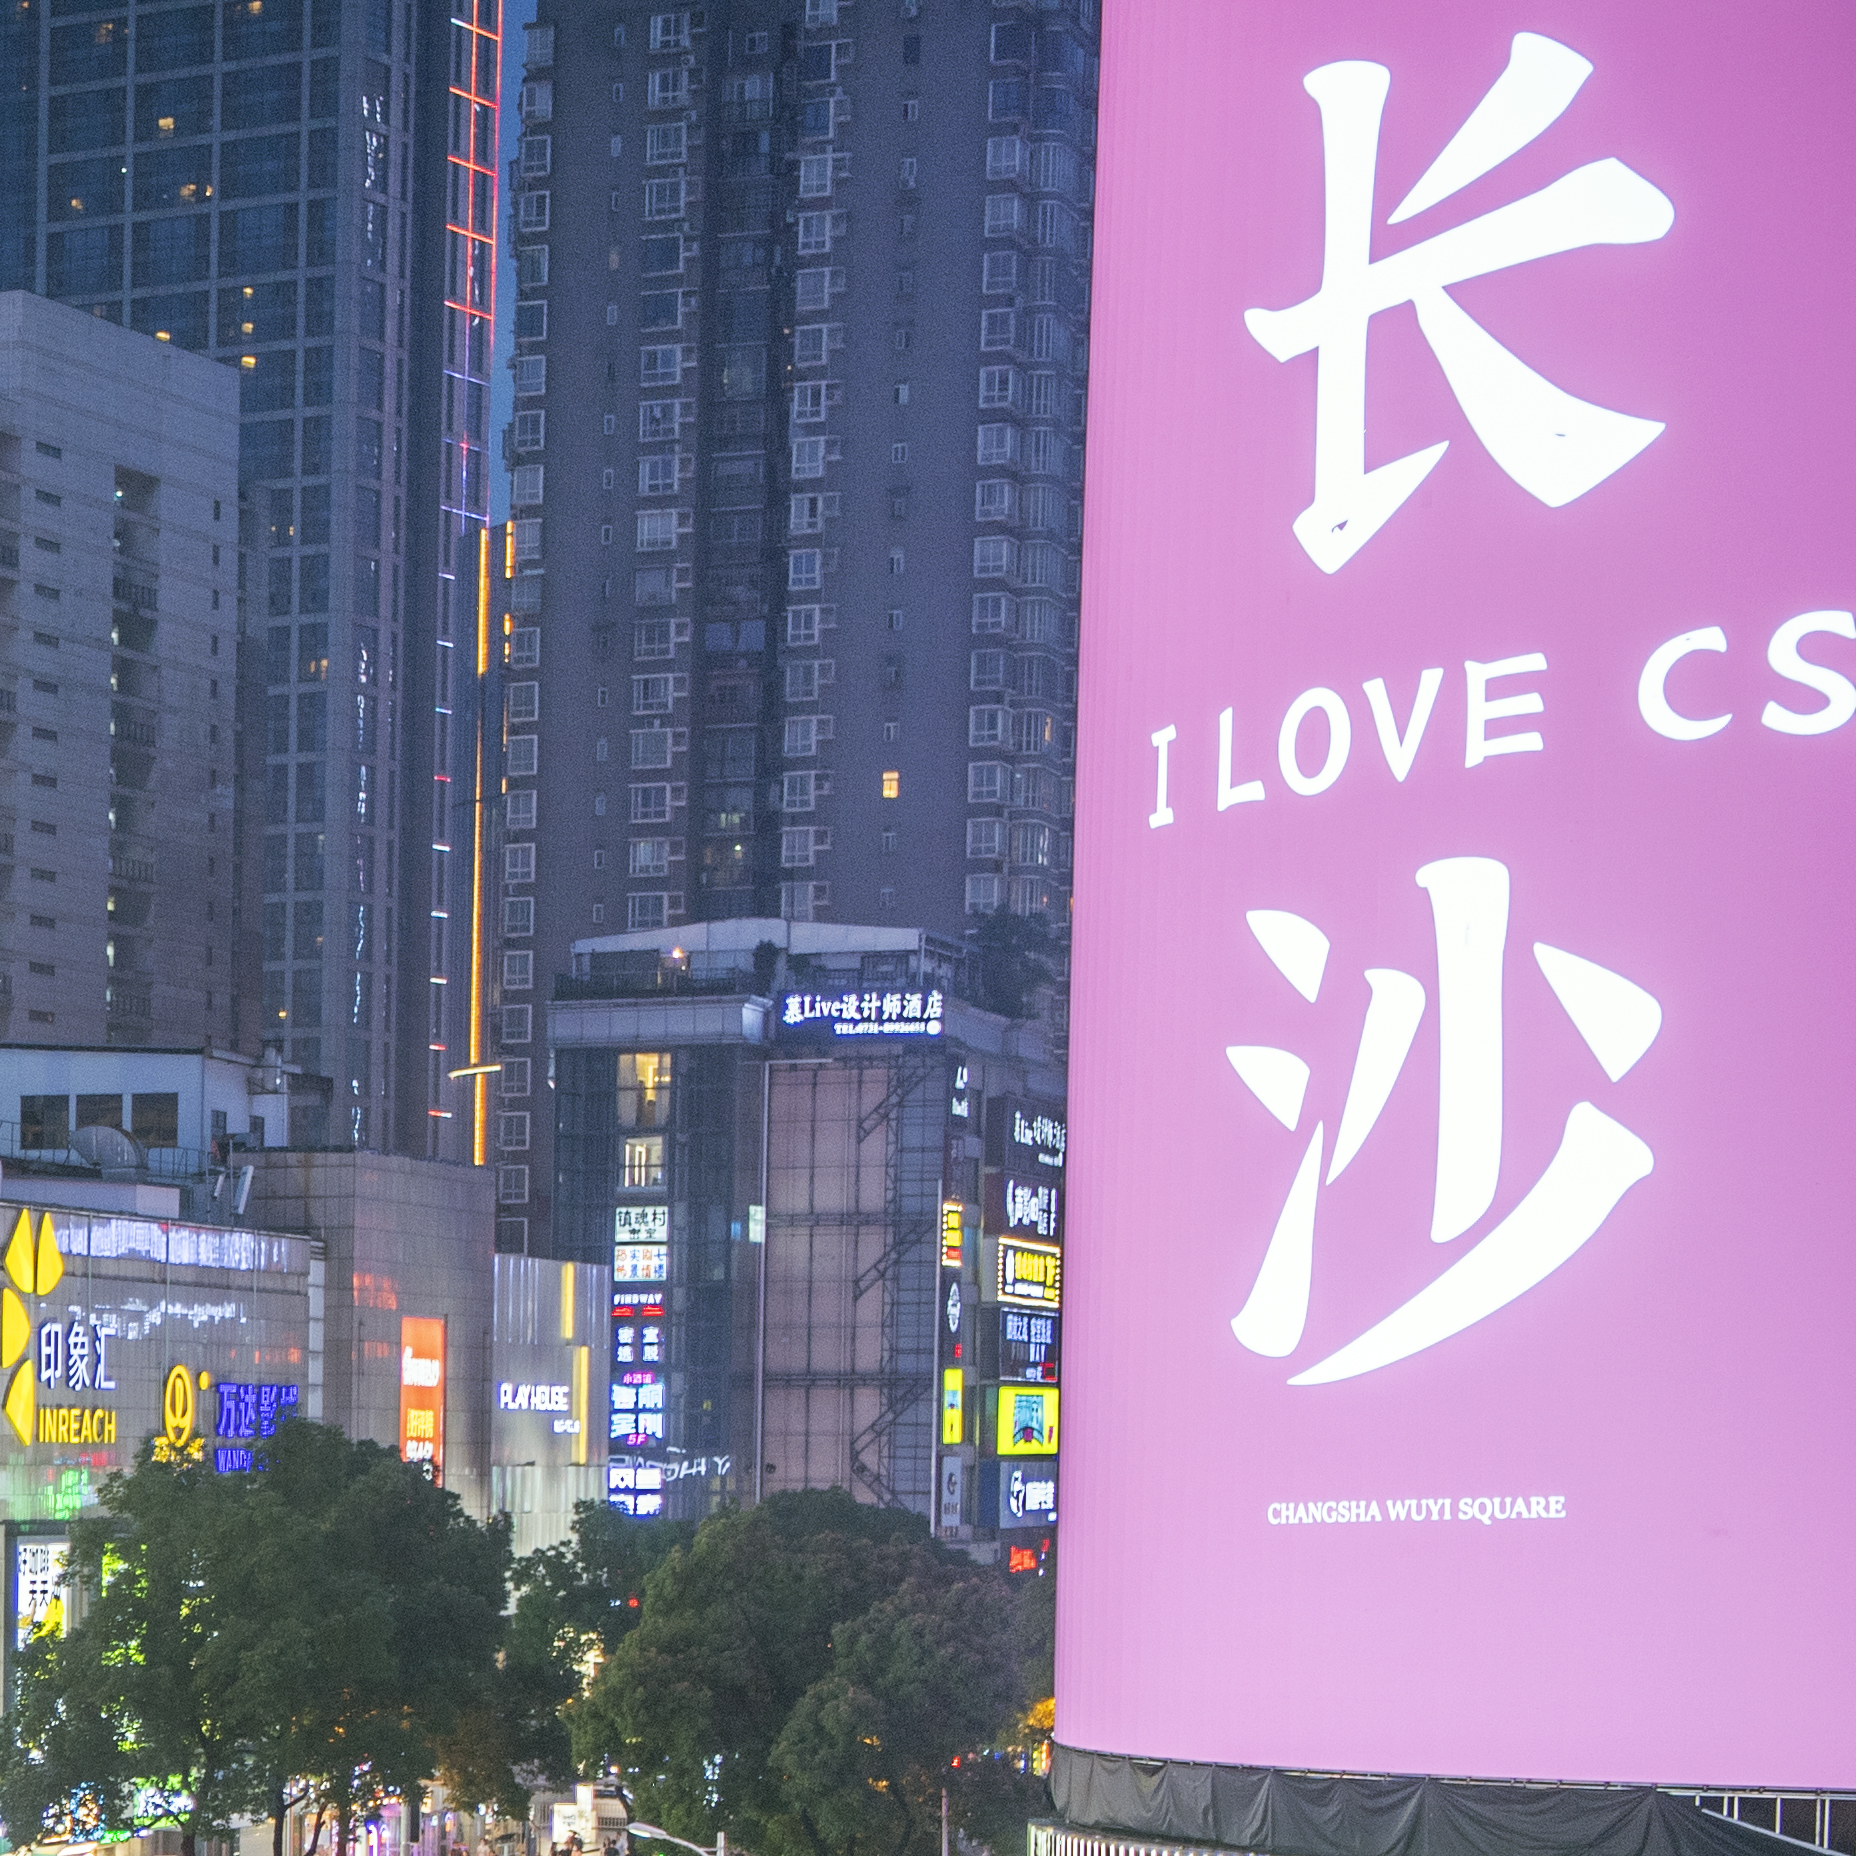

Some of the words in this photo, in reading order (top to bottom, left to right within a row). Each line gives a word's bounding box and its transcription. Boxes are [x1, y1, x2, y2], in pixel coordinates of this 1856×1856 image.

[1244, 33, 1674, 574] 长
[1149, 725, 1176, 828] I
[1218, 653, 1547, 811] LOVE
[1638, 611, 1856, 740] CS
[1226, 857, 1661, 1385] 沙
[38, 1320, 116, 1390] 印象汇
[38, 1408, 116, 1445] INREACH
[217, 1383, 298, 1438] 万达影
